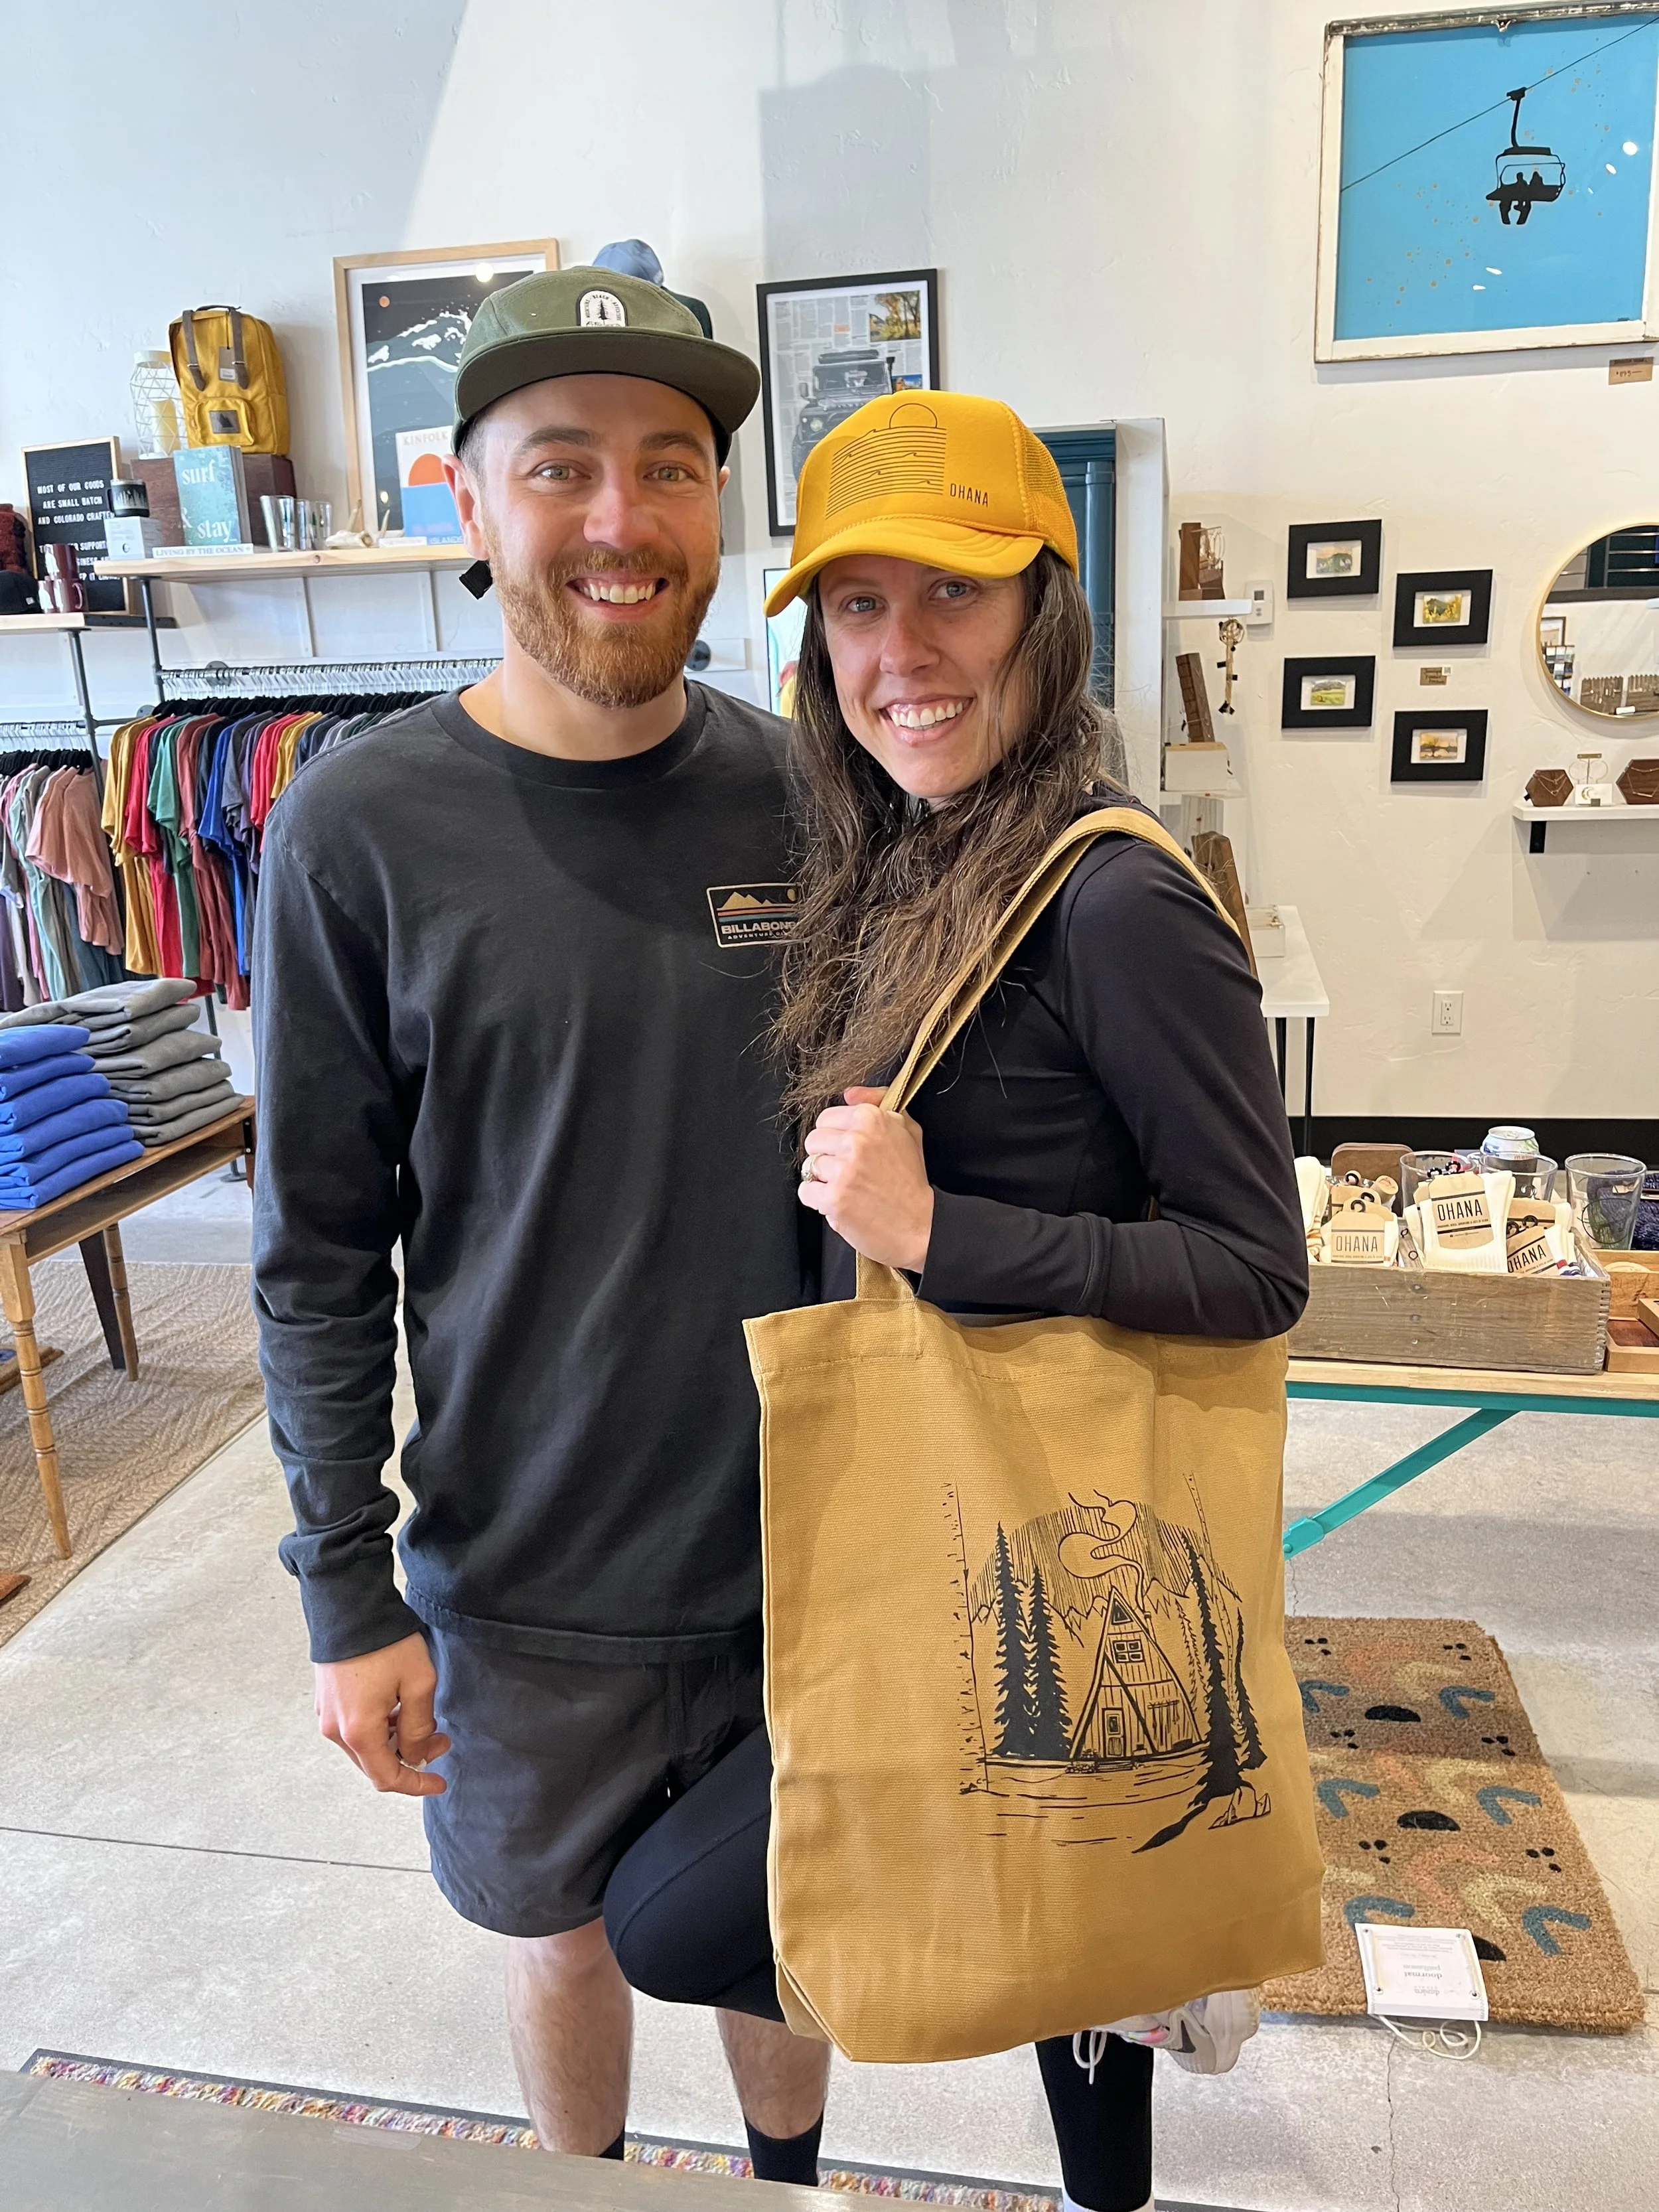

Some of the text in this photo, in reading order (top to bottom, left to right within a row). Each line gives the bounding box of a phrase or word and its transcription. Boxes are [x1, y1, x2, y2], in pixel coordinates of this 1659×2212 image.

[403, 431, 449, 445] KINFOLK
[181, 459, 216, 484] surf
[36, 484, 54, 494] MOST
[57, 483, 66, 492] OF
[68, 482, 81, 491] OUR
[950, 483, 988, 508] OHANA
[42, 496, 103, 509] ARE SMALL BATCH
[38, 516, 50, 525] AND
[54, 513, 84, 524] COLORADO
[197, 520, 232, 543] stay
[1437, 1199, 1482, 1221] OHANA
[1336, 1235, 1378, 1252] OHANA
[1507, 1244, 1547, 1273] OHANA
